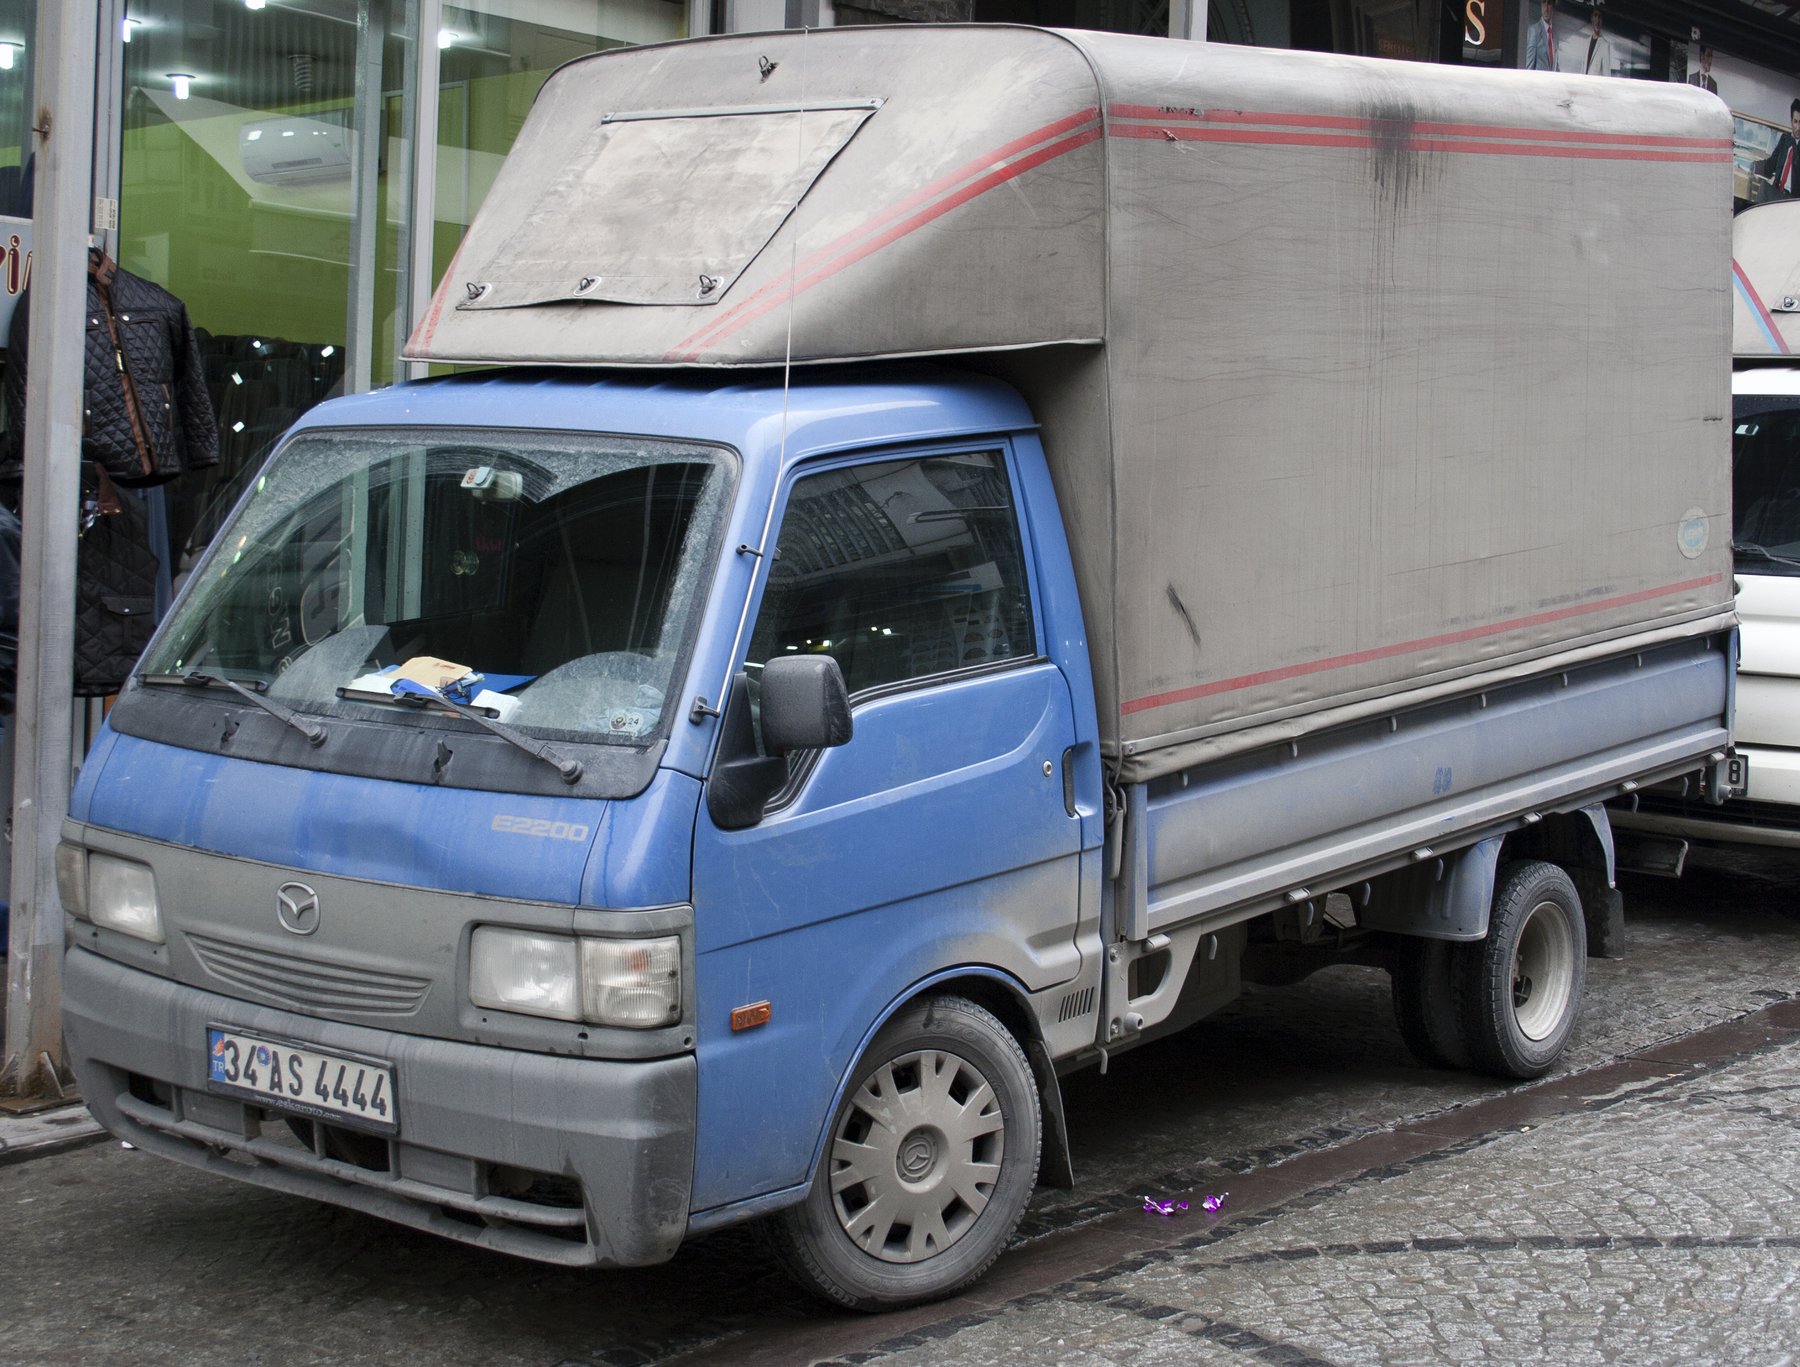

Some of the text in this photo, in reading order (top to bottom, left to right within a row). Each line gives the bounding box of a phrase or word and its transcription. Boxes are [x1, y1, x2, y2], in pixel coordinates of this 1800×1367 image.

[1464, 0, 1486, 46] S
[491, 814, 590, 842] E2200
[213, 1060, 225, 1074] TR
[224, 1039, 387, 1116] 34 AS 4444
